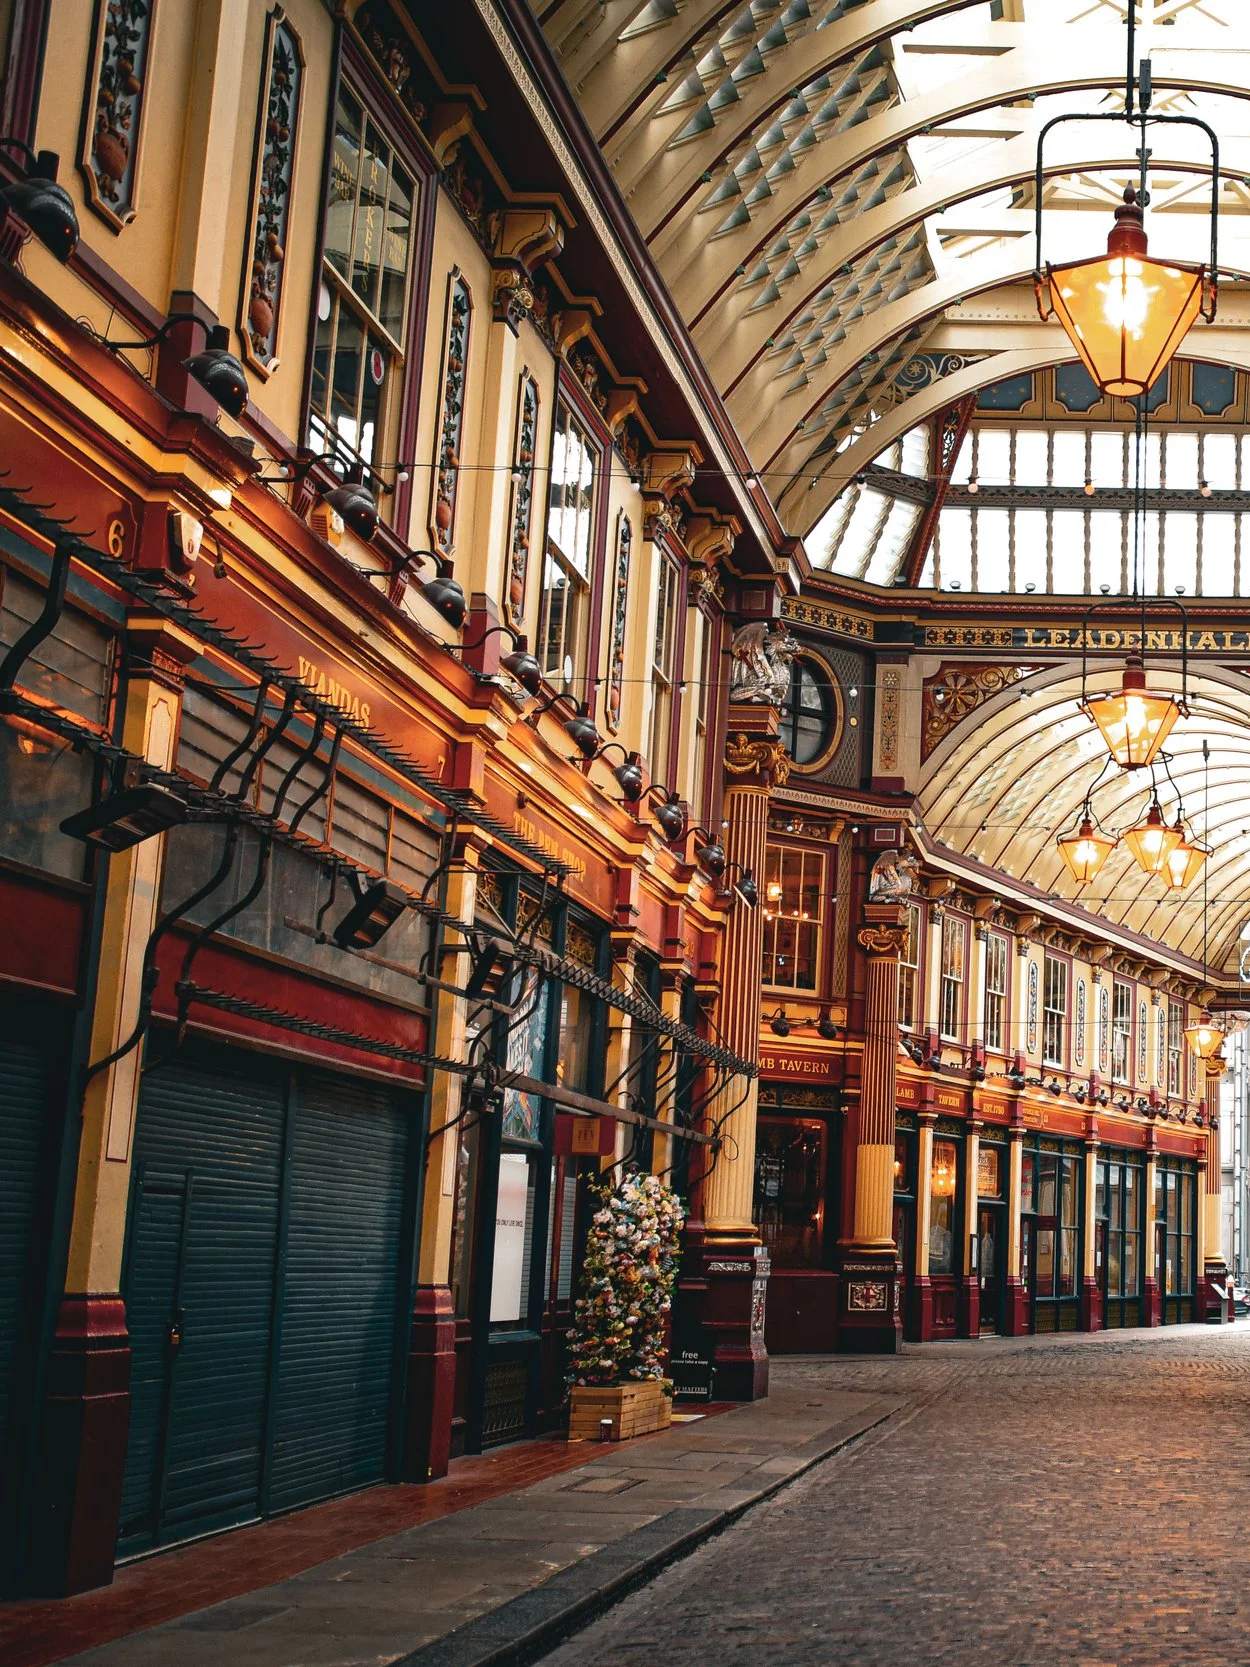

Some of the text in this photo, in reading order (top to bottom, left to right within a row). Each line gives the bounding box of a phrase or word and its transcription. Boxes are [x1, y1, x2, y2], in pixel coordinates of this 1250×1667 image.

[108, 519, 125, 558] 6
[298, 655, 371, 733] VIANDAS
[438, 755, 446, 783] 7
[513, 811, 536, 841] THE
[779, 1059, 830, 1074] TAVERN
[896, 1086, 915, 1100] LAMB
[938, 1094, 961, 1108] TAVERN
[682, 1350, 699, 1359] free
